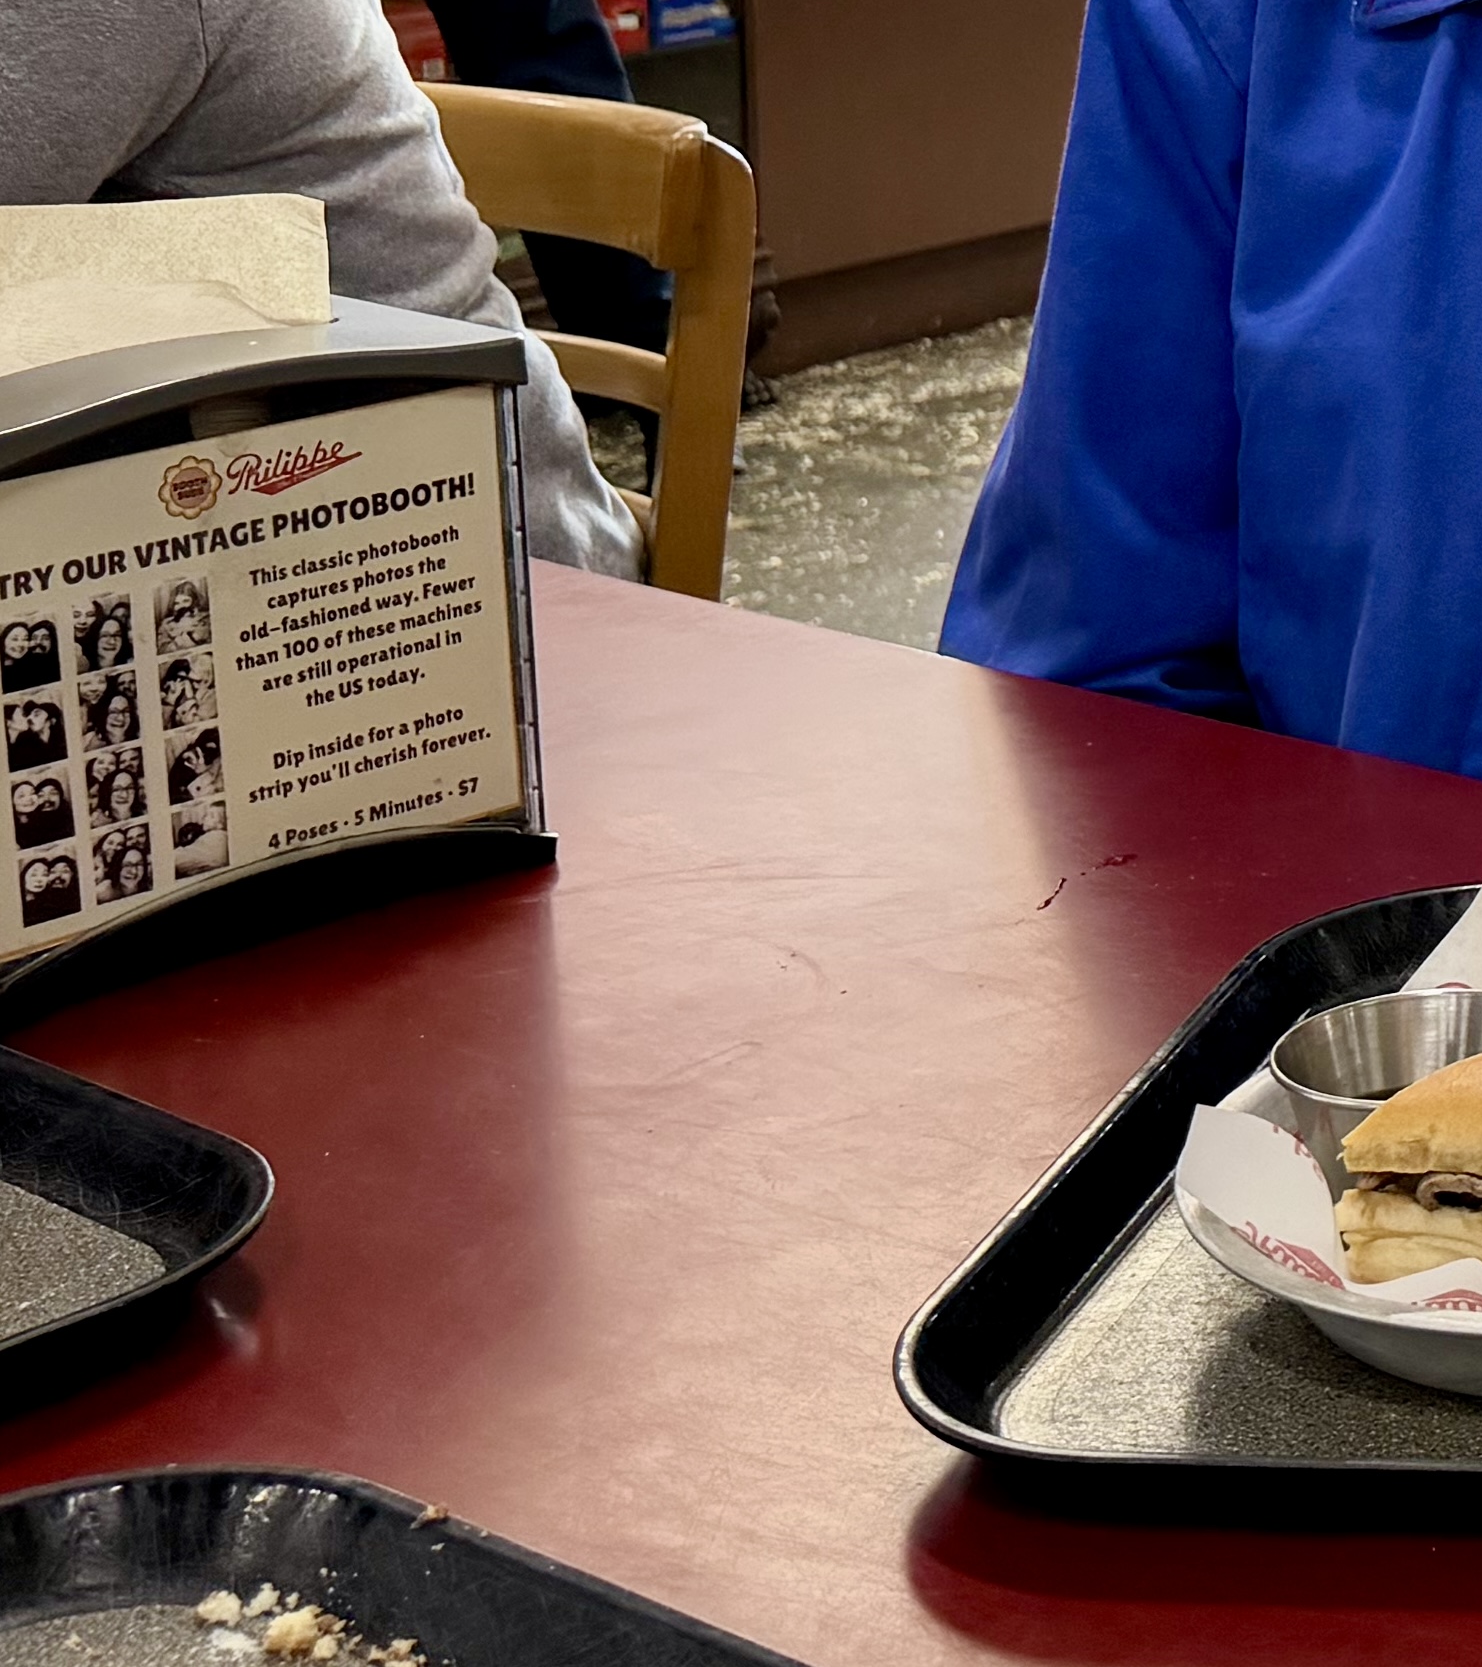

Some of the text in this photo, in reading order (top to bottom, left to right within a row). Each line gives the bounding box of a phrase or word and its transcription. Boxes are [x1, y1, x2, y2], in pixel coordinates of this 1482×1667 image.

[226, 439, 352, 496] Philippe
[0, 472, 476, 600] TRY OUR VINTAGE PHOTOBOOTH!
[249, 525, 460, 586] This classic photobooth
[267, 557, 446, 609] captures photos the
[375, 590, 419, 610] way.
[422, 576, 476, 599] Fewer
[236, 600, 482, 671] than 100 of these machines
[262, 629, 462, 691] are still operational in
[306, 667, 426, 707] the US today.
[249, 727, 492, 804] strip you'll cherish forever.
[273, 708, 464, 769] Dip inside for a photo
[268, 776, 479, 849] 4 Poses 5 Minutes $7
